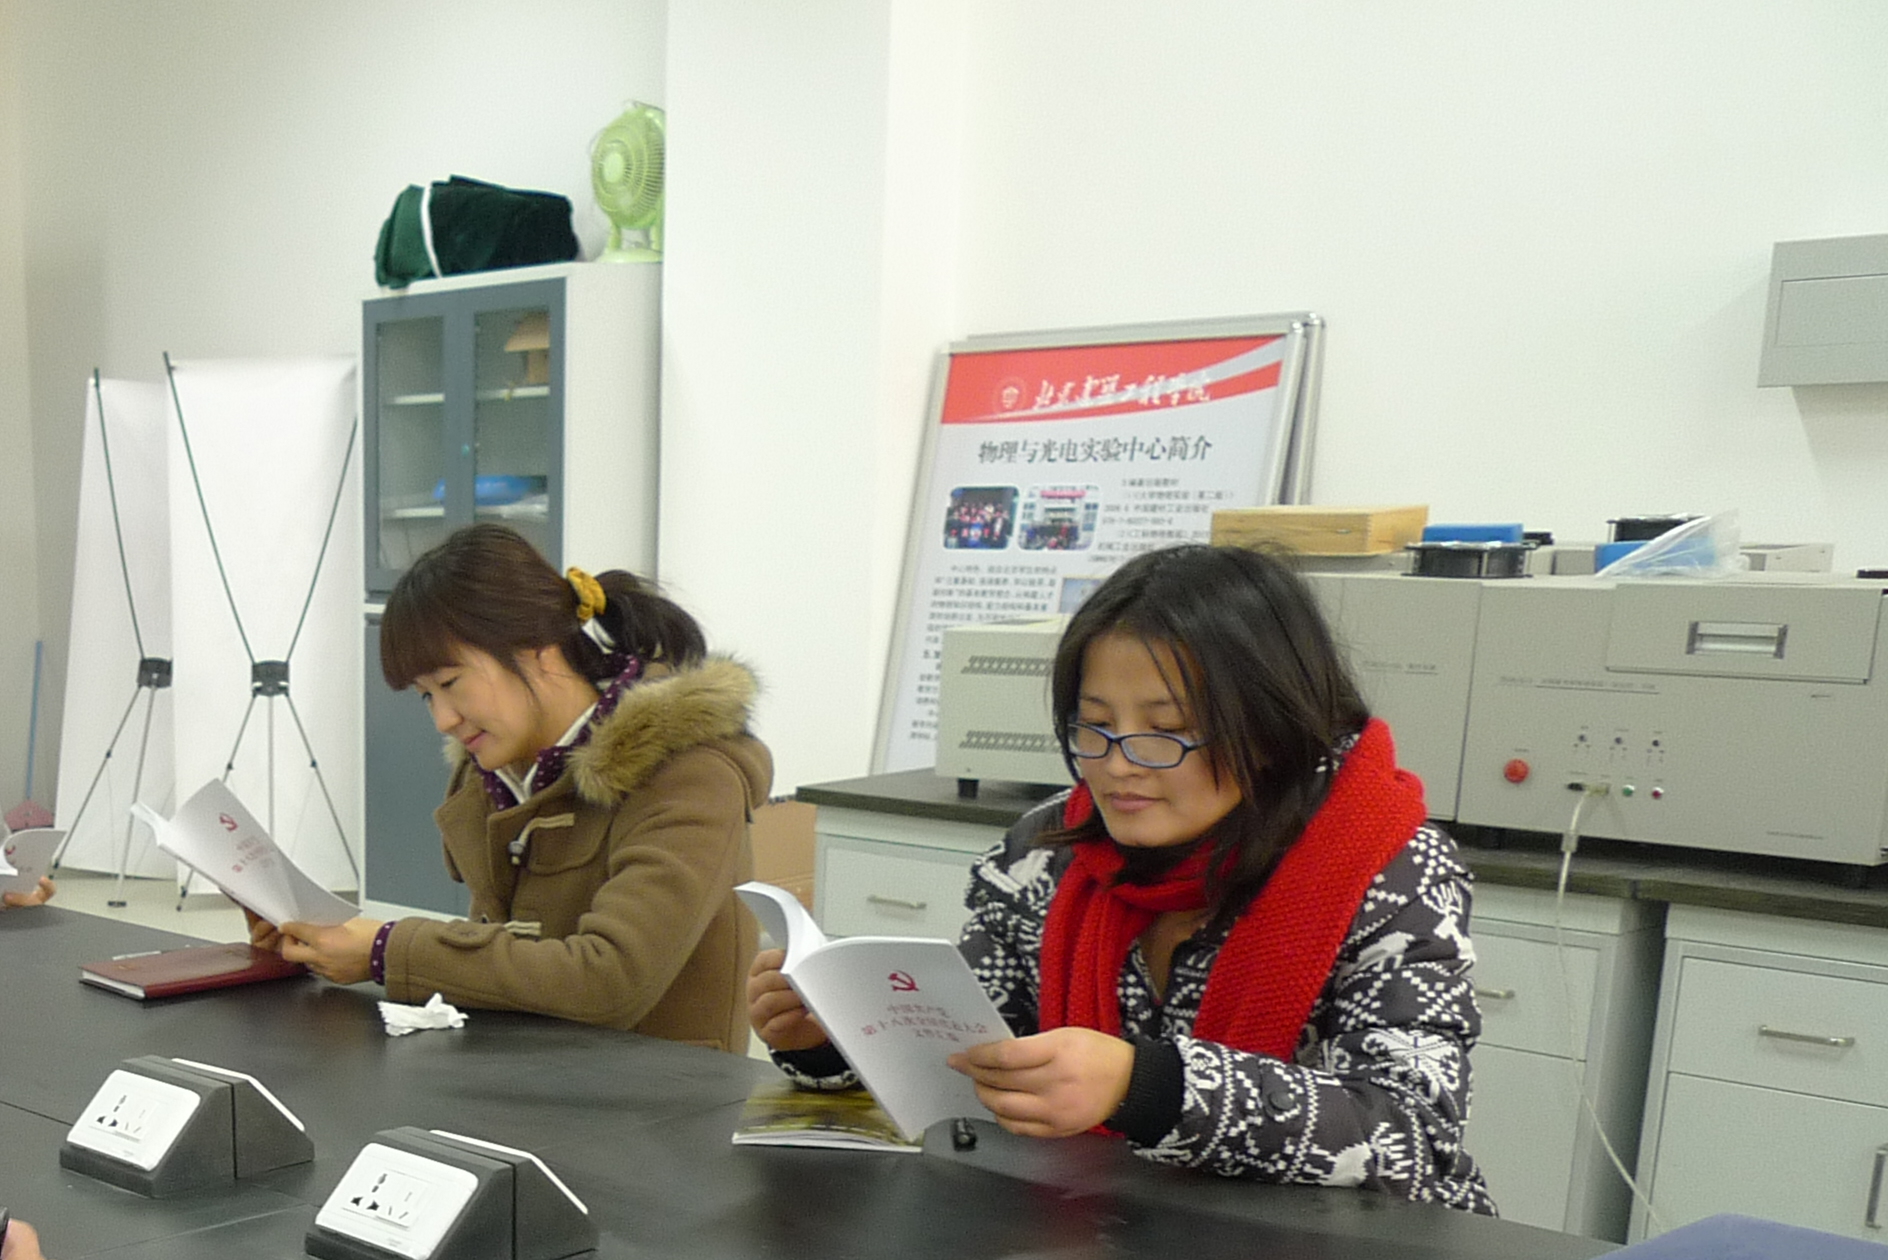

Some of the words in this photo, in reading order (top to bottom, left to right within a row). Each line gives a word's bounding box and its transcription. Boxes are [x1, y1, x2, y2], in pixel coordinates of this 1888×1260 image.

[978, 434, 1213, 464] 物理与光电实验中心简介
